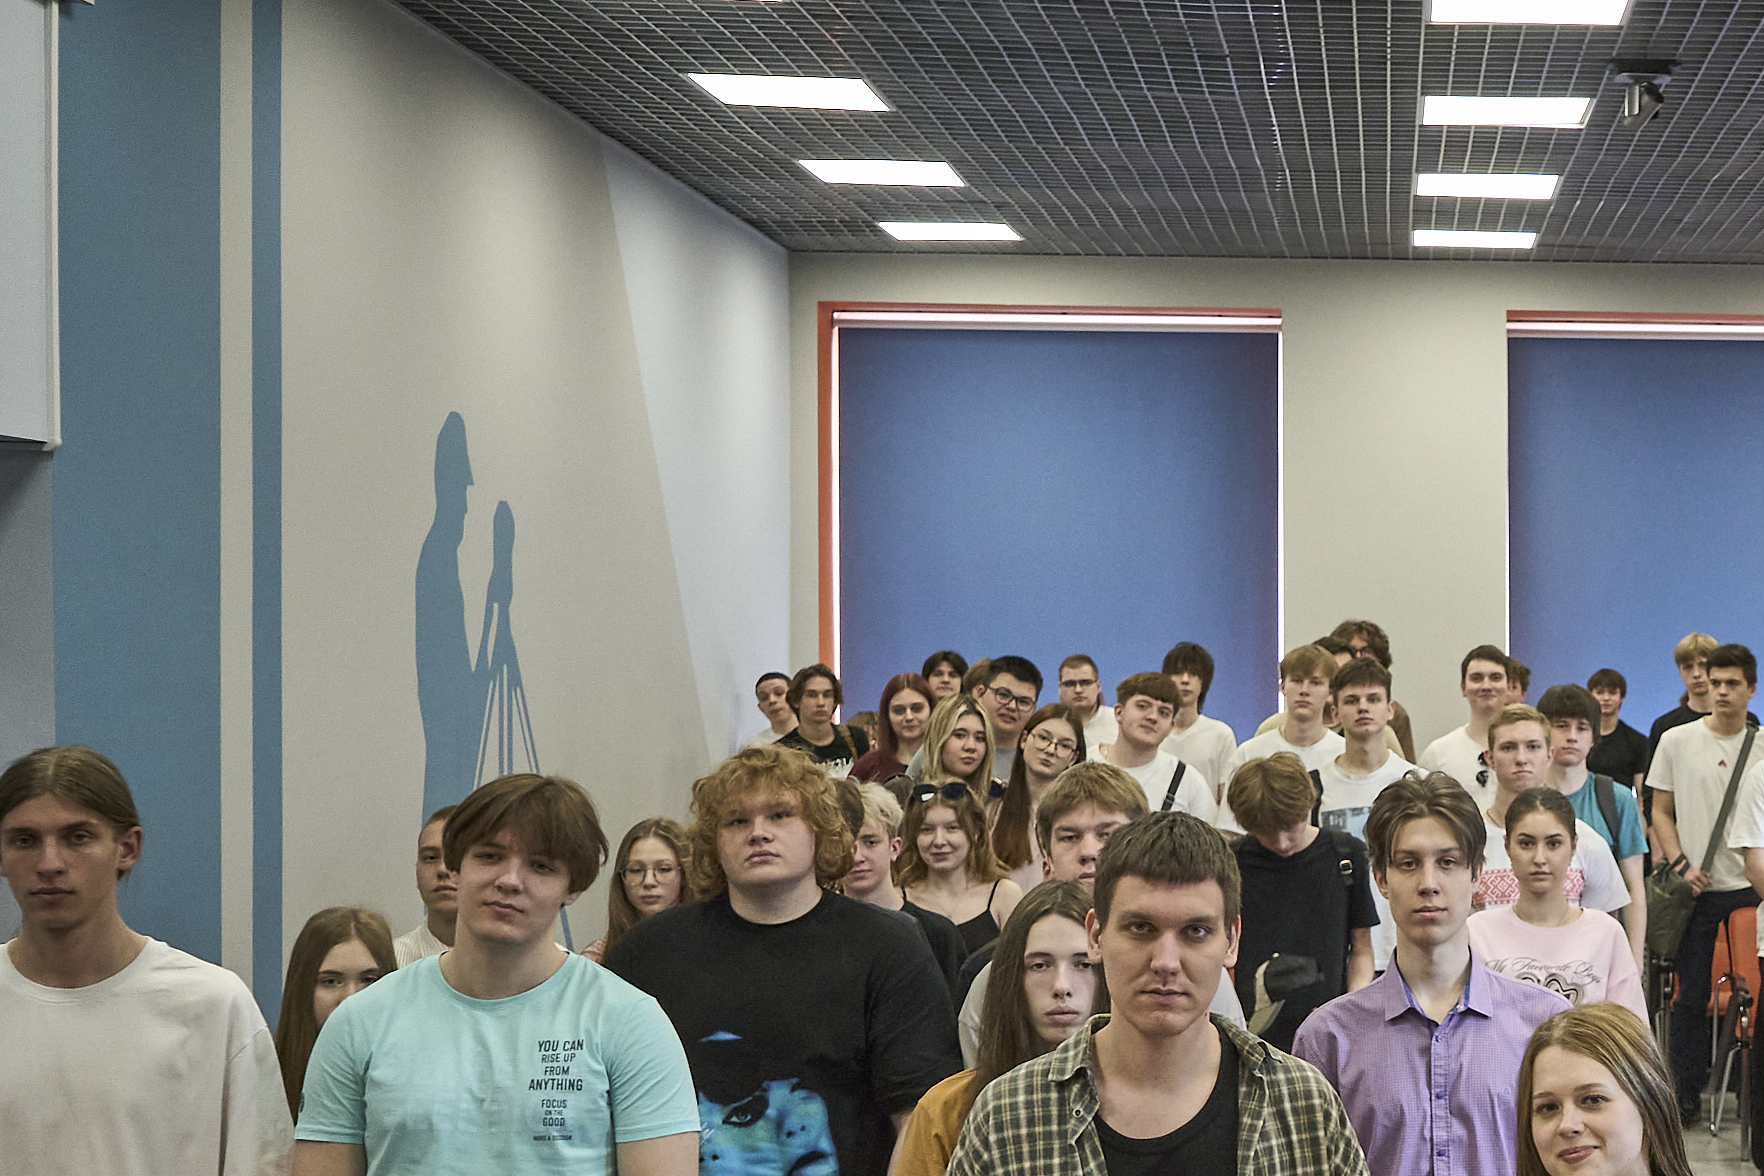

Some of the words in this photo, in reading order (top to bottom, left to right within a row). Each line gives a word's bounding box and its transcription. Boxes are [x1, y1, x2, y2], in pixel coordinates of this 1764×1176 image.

[538, 1040, 559, 1052] YOU
[563, 1039, 584, 1051] CAN
[541, 1053, 561, 1063] RISE
[563, 1052, 576, 1062] UP
[544, 1065, 570, 1076] FROM
[528, 1078, 583, 1091] ANYTHING
[541, 1099, 567, 1109] FOCUS
[542, 1117, 566, 1127] GOOD
